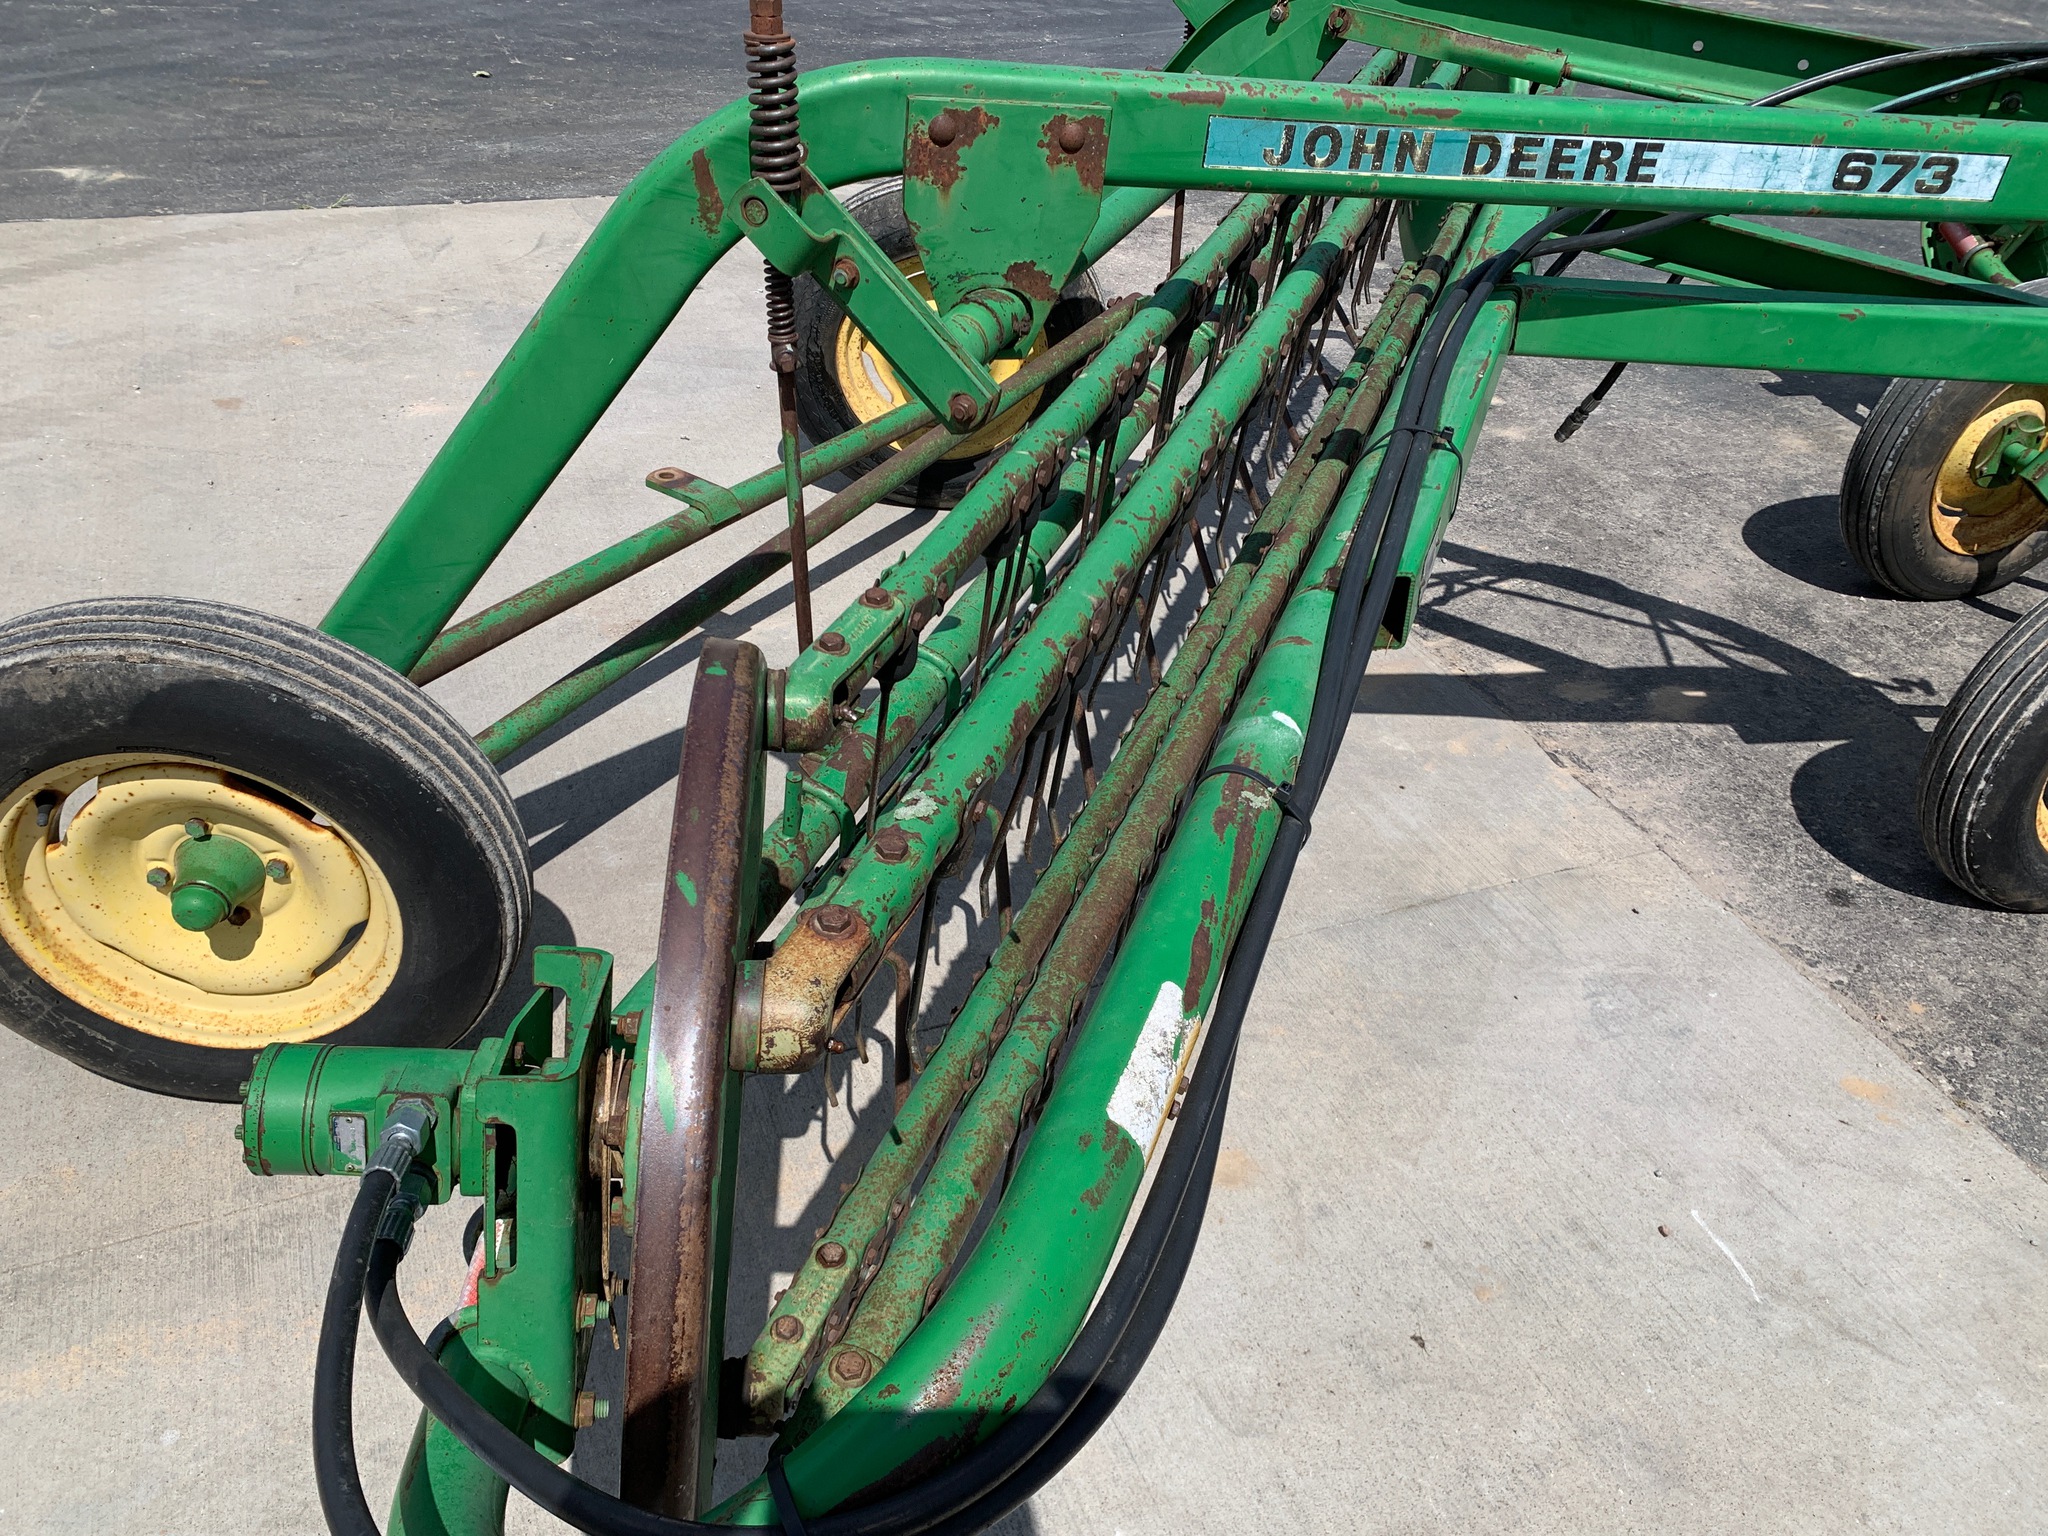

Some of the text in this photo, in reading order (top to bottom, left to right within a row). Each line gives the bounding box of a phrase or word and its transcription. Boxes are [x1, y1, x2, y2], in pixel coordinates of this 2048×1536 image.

[1263, 124, 1960, 194] JOHN DEERE 673
